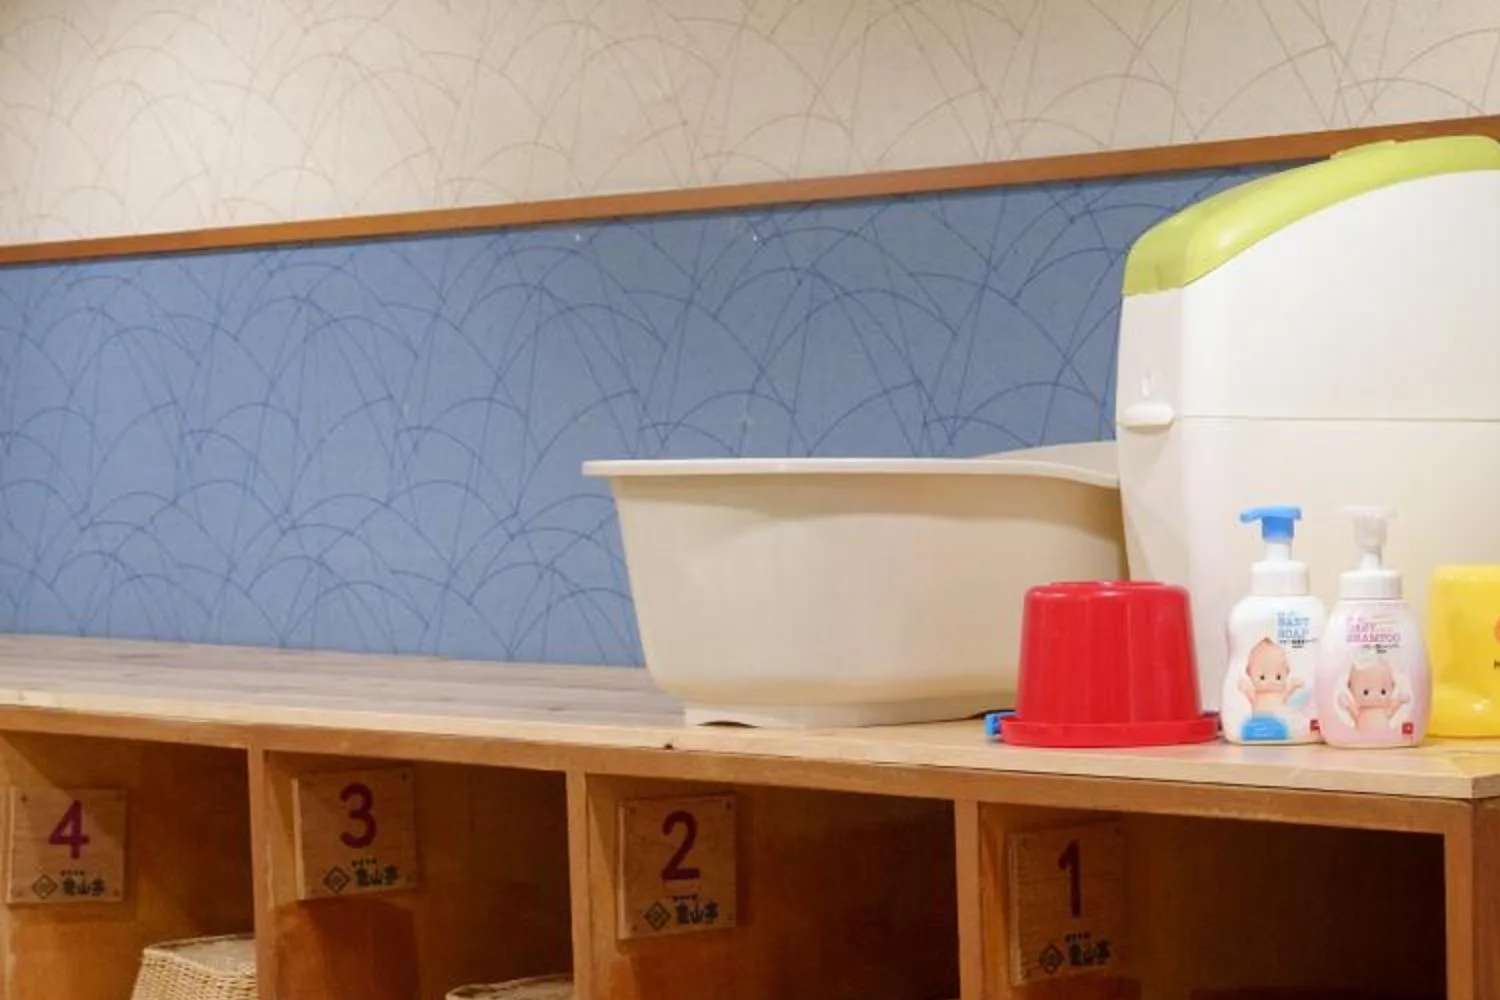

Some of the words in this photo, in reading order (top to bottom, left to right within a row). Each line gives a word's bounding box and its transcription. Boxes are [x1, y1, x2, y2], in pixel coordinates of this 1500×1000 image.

[48, 800, 90, 859] 4
[340, 783, 377, 848] 3
[661, 809, 701, 881] 2
[1058, 838, 1082, 918] 1
